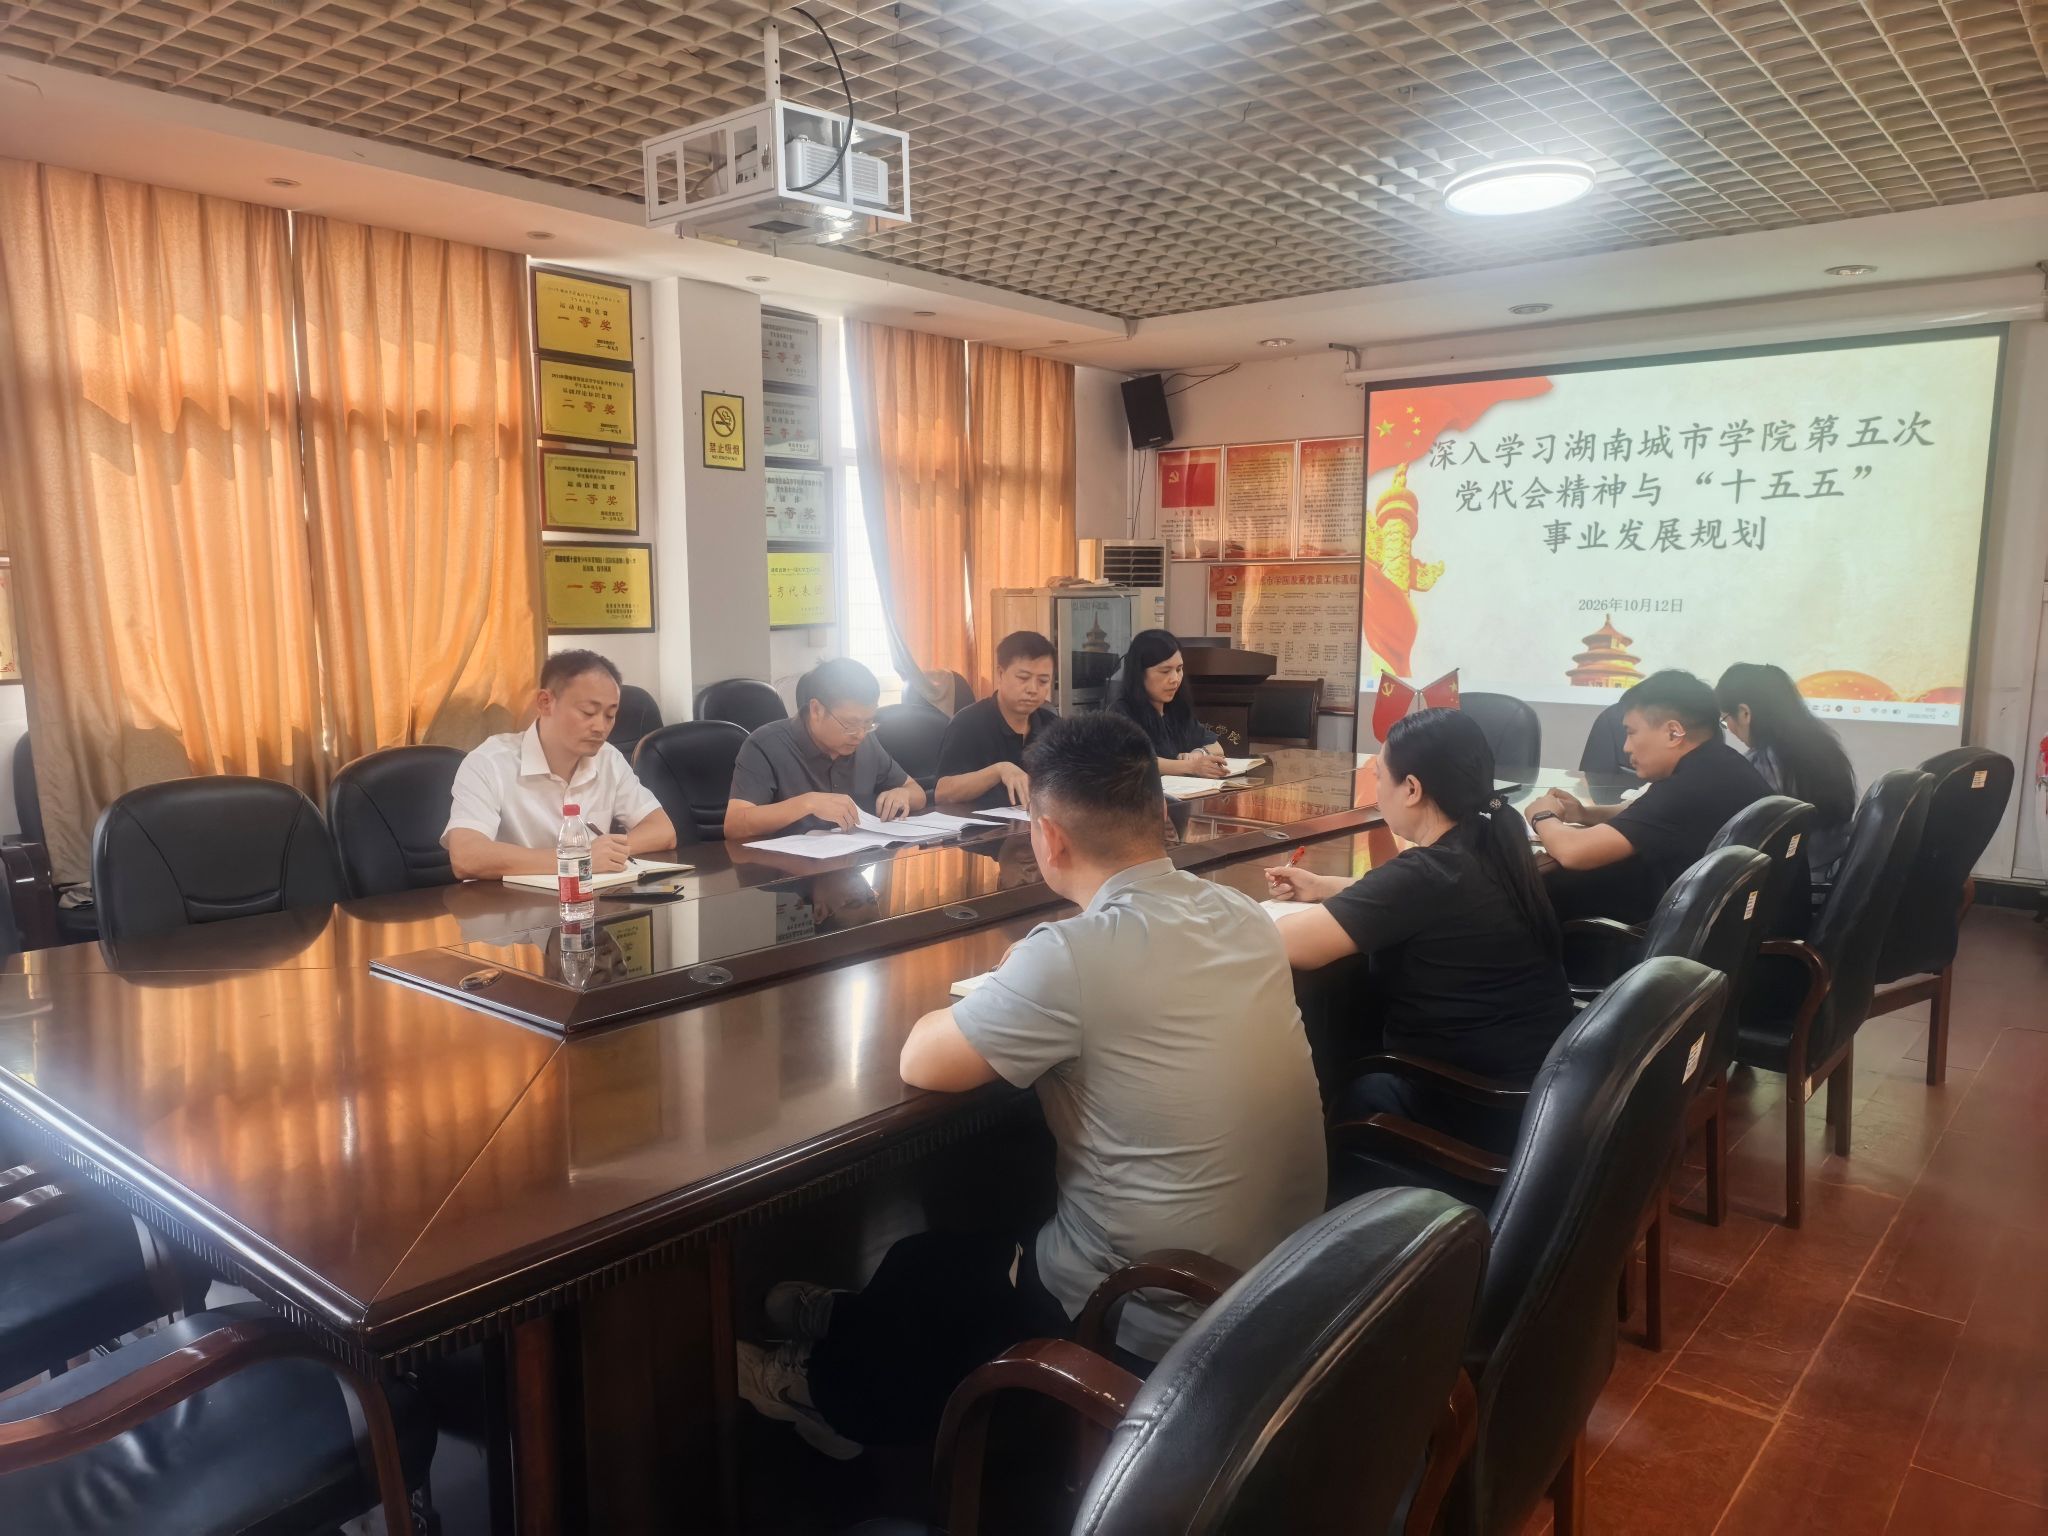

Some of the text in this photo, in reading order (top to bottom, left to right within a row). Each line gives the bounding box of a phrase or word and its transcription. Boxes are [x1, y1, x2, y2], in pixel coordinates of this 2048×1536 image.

[558, 316, 612, 332] 一等奖
[562, 399, 616, 415] 二等奖
[709, 442, 740, 455] 禁止吸烟
[1429, 411, 1935, 471] 深入学习湖南城市学院第五次
[565, 493, 618, 506] 二等奖
[765, 506, 816, 520] 三等奖
[1543, 516, 1767, 554] 事业发展规划
[566, 580, 629, 594] 一等奖
[1578, 597, 1684, 613] 2026年10月12日
